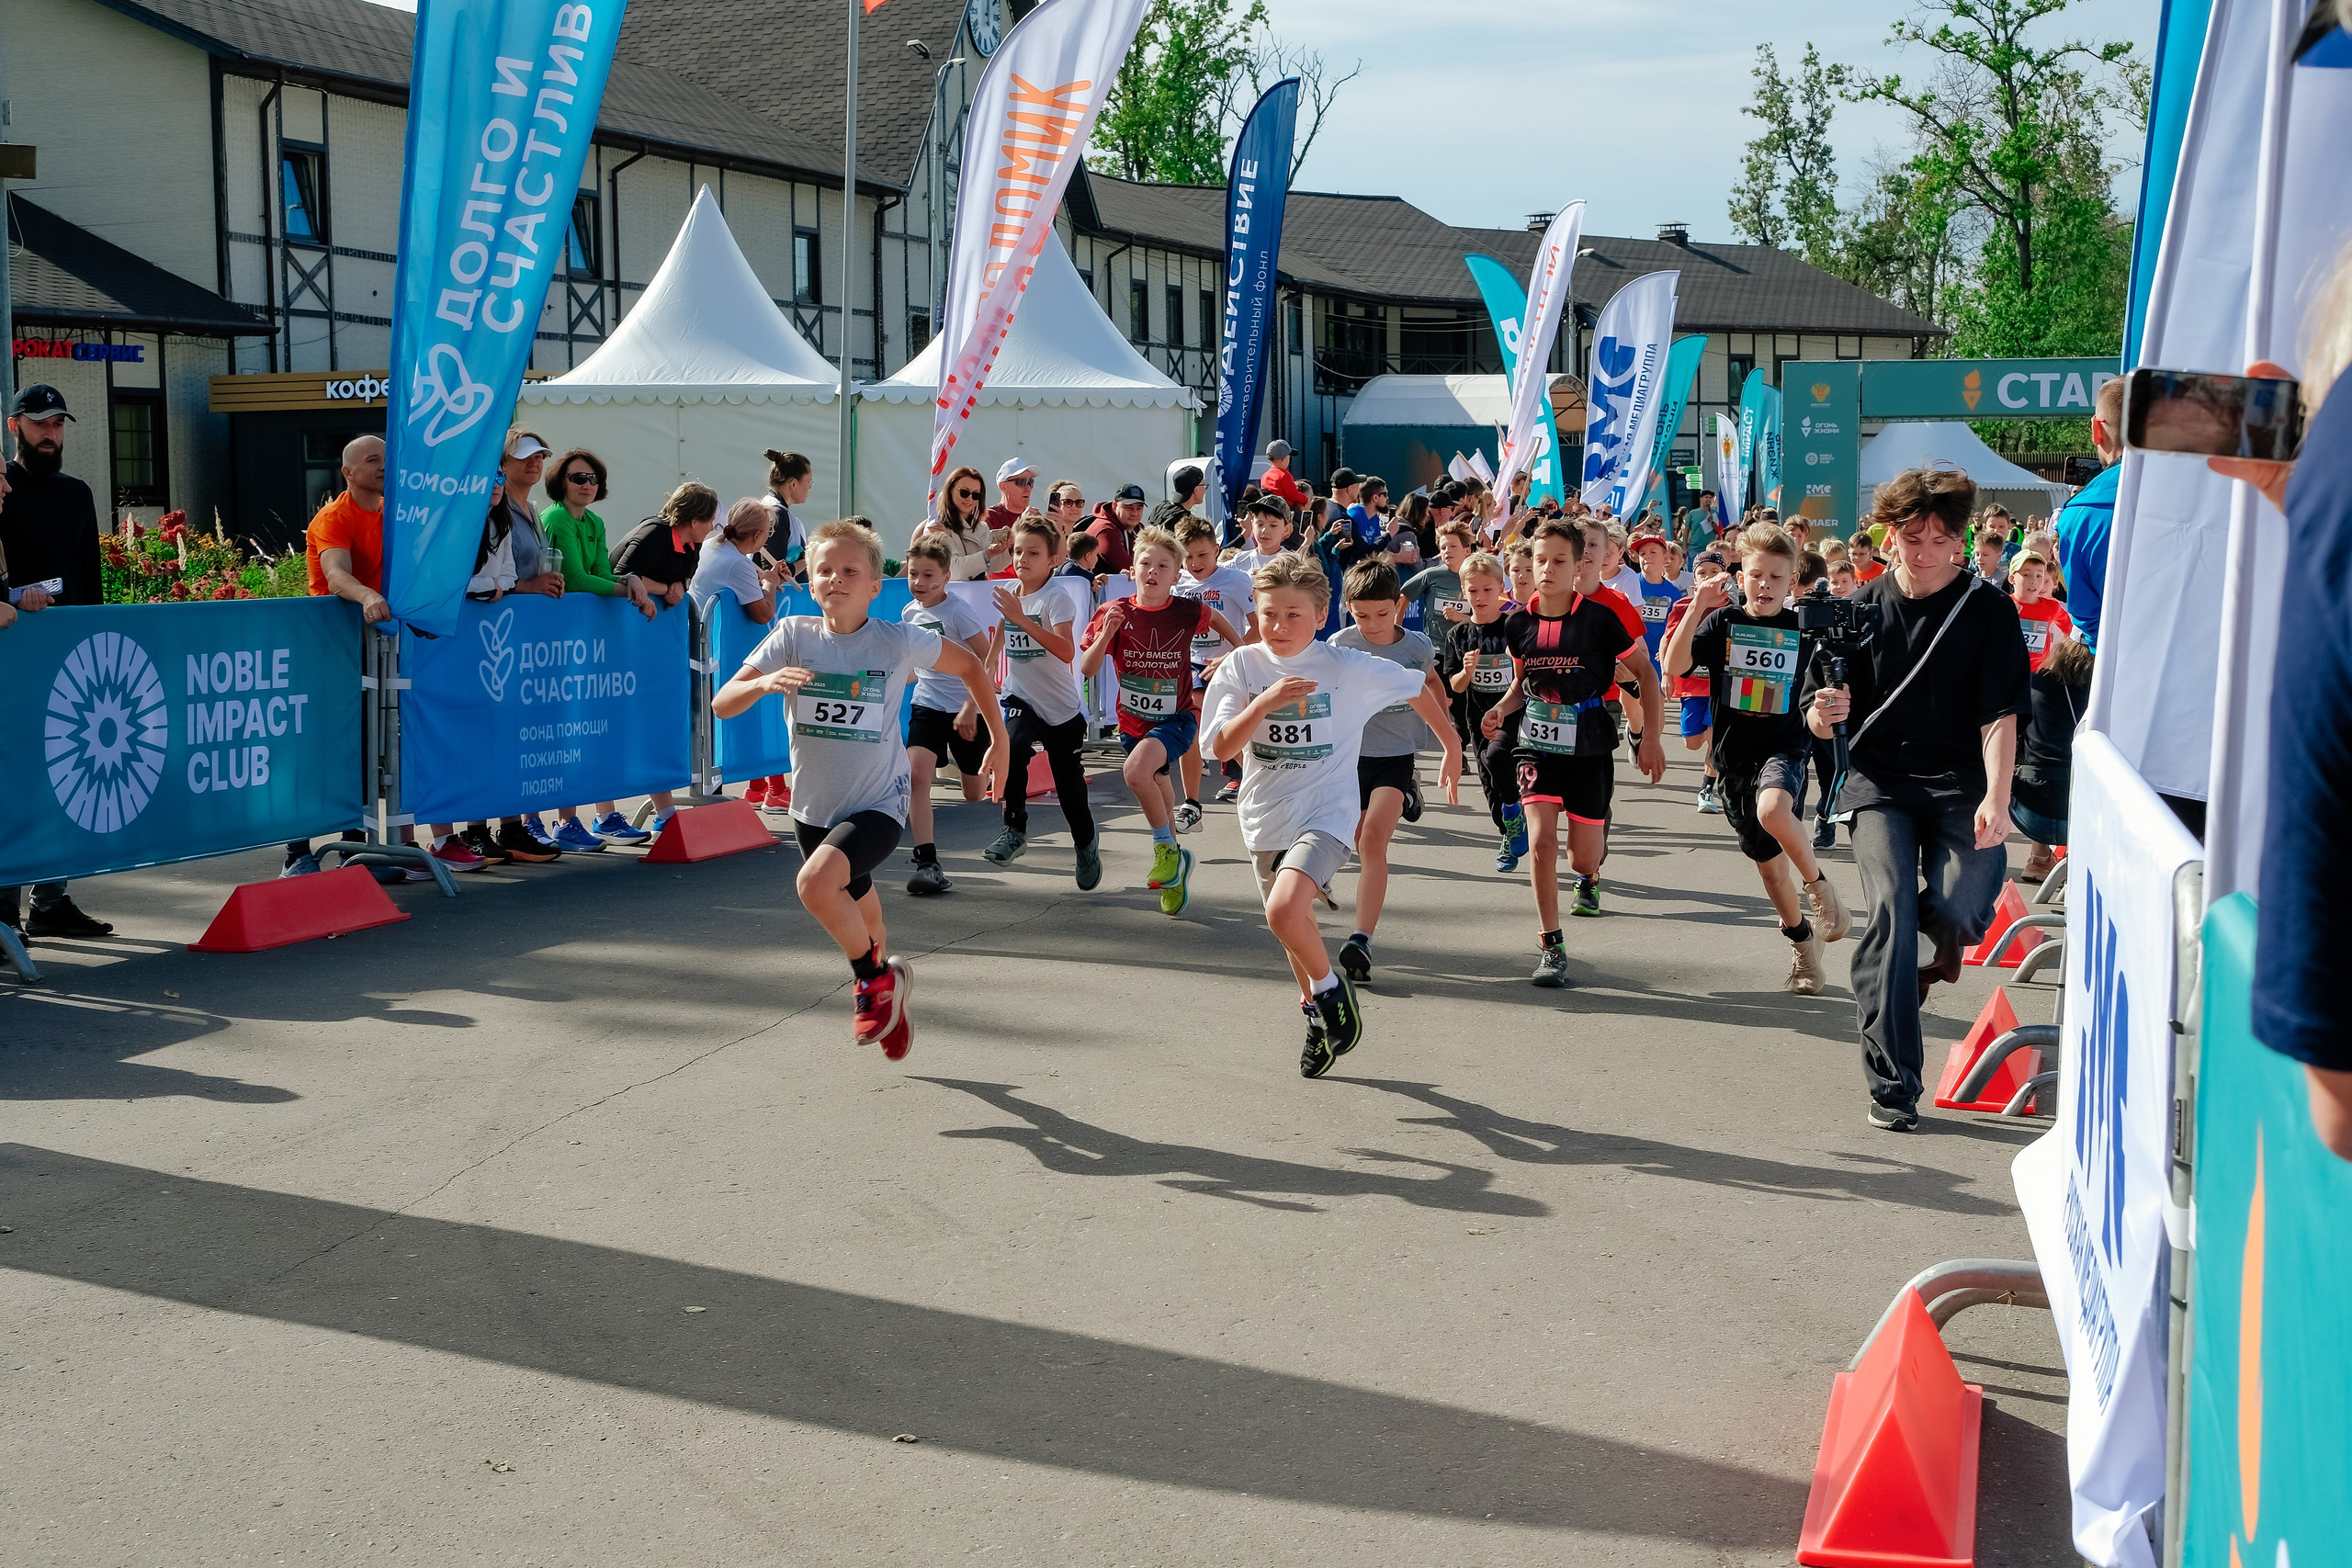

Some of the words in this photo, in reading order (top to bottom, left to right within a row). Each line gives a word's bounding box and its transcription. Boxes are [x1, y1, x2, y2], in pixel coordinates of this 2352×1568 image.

[435, 118, 517, 331] ДОЛГО
[492, 56, 534, 97] И
[75, 344, 144, 363] СЕРВИС
[1010, 635, 1030, 648] 511
[519, 639, 587, 673] ДОЛГО
[593, 638, 605, 663] И
[1123, 649, 1145, 659] БЕГУ
[1147, 651, 1182, 660] ВМЕСТЕ
[1745, 649, 1785, 669] 560
[187, 649, 289, 695] NOBLE
[1475, 671, 1502, 683] 559
[520, 671, 637, 705] СЧАСТЛИВО
[1130, 694, 1163, 711] 504
[187, 694, 309, 745] IMPACT
[814, 702, 865, 725] 527
[519, 725, 554, 741] ФОНД
[557, 719, 608, 738] ПОМОЩИ
[1269, 724, 1312, 744] 881
[1531, 722, 1559, 741] 531
[520, 749, 582, 769] ПОЖИЛЫМ
[187, 745, 270, 794] CLUB
[521, 776, 563, 796] ЛЮДЯМ
